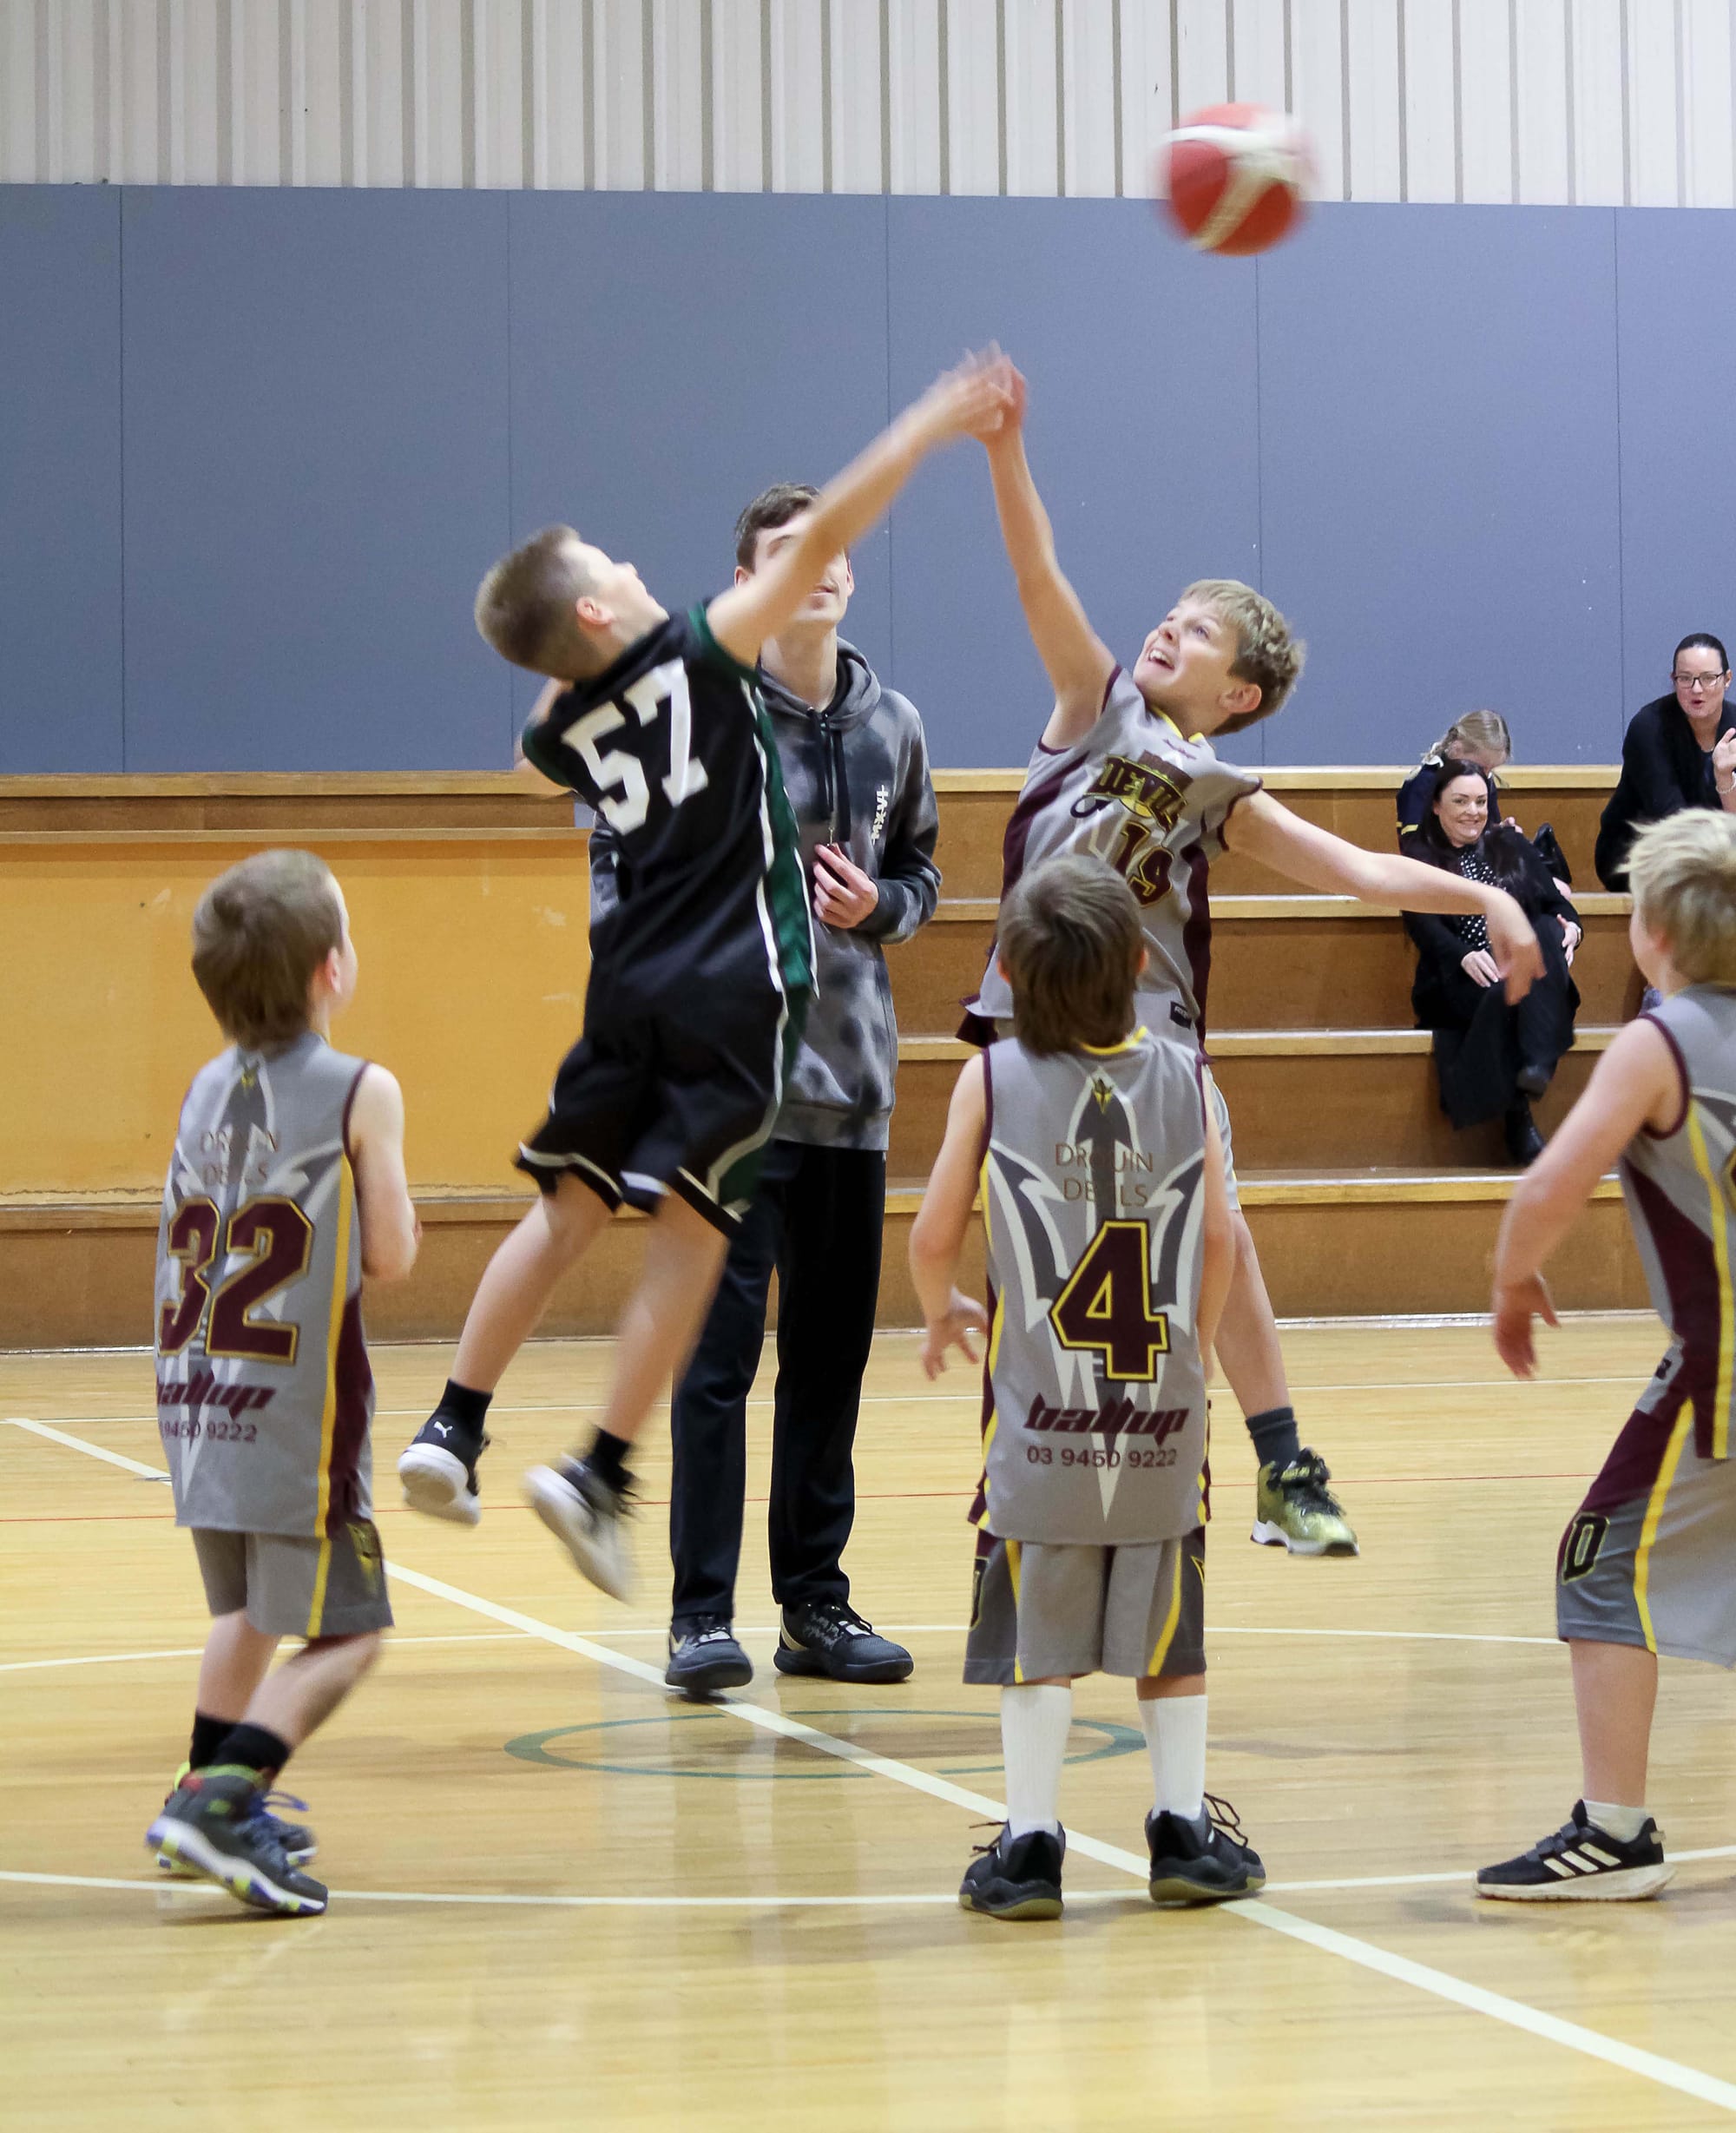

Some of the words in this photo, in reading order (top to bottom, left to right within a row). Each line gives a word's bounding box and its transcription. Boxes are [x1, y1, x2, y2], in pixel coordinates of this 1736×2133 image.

[561, 655, 709, 836] 57
[158, 1194, 314, 1367] 32
[1049, 1218, 1172, 1384] 4
[1026, 1445, 1054, 1465] 03
[1060, 1447, 1121, 1468] 9450
[1128, 1447, 1178, 1469] 9222
